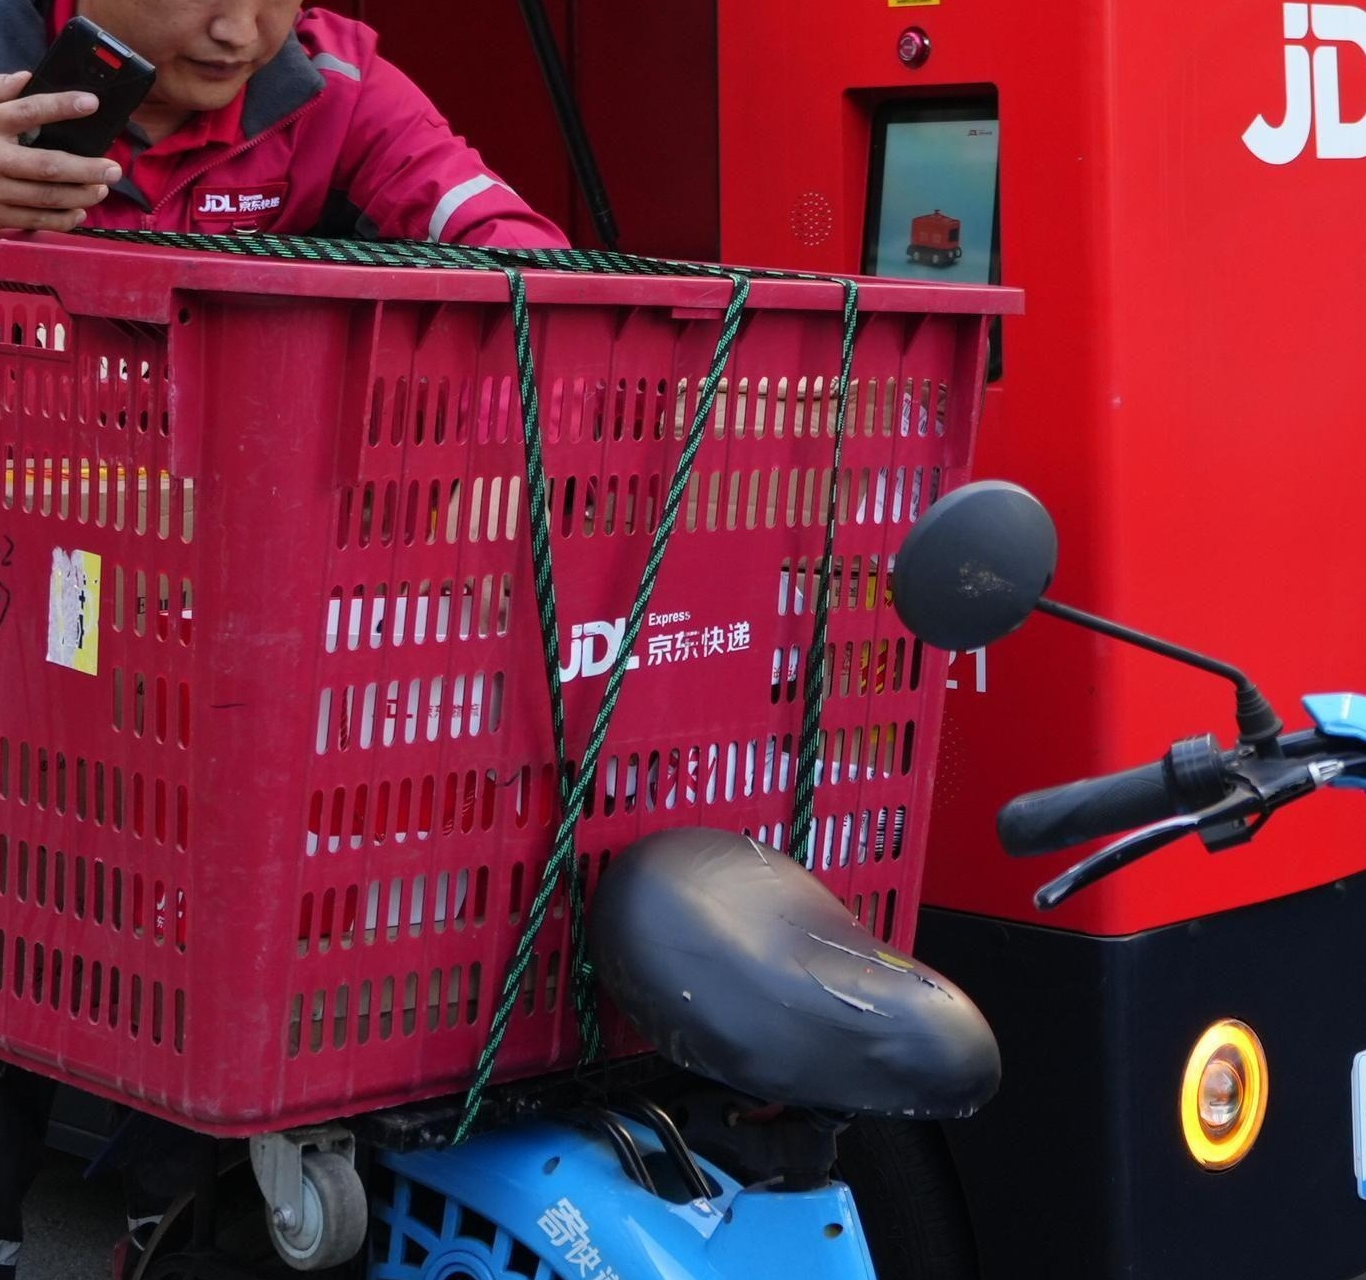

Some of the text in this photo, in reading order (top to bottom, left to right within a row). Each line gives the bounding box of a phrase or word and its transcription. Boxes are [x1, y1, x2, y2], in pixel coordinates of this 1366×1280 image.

[198, 194, 236, 212] JDL
[648, 611, 691, 627] Express
[559, 616, 640, 683] JDL
[648, 621, 751, 666] 京东快递
